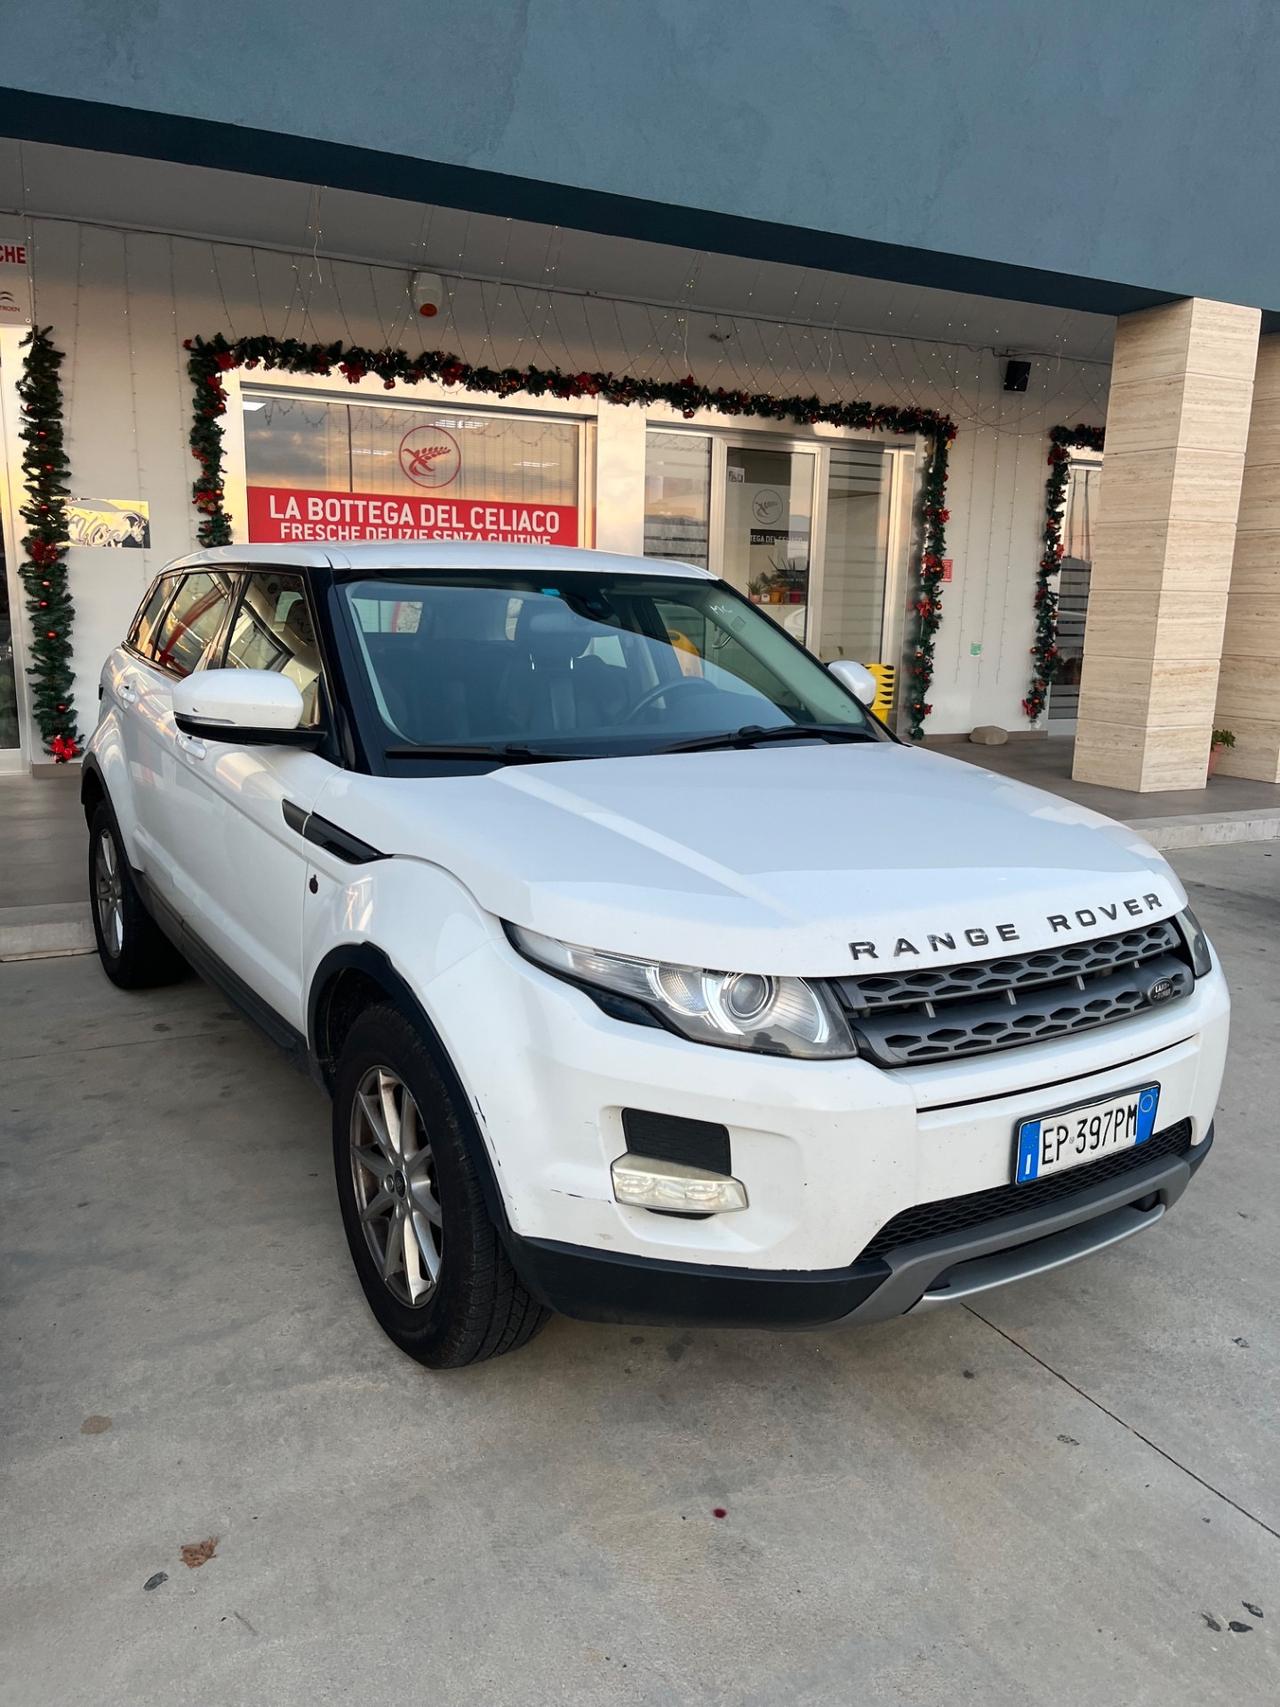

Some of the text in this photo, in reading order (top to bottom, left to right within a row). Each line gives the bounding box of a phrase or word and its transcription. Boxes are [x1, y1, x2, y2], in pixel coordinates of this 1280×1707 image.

[269, 495, 560, 534] LA BOTTEGA DEL CELIACO
[280, 522, 361, 541] FRESCHE
[847, 892, 1164, 961] RANGE ROVER
[1041, 1103, 1138, 1166] EP 397PM
